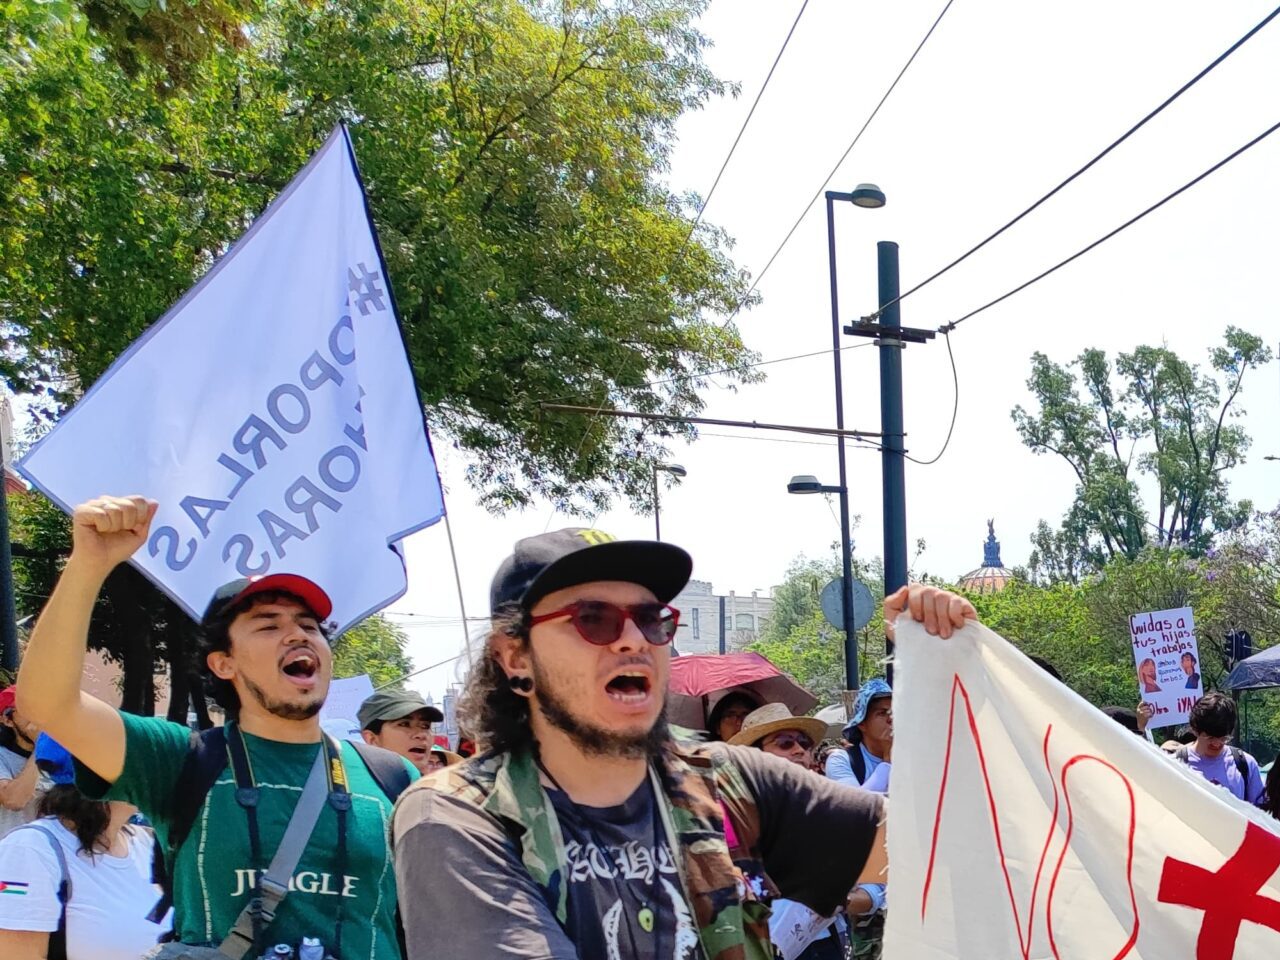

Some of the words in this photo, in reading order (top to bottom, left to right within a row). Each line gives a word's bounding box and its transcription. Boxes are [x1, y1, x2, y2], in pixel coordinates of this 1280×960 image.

[1130, 613, 1172, 635] Cuidas
[1176, 617, 1185, 629] a
[1133, 636, 1156, 649] tus
[1162, 630, 1190, 644] hijas
[1151, 641, 1193, 657] trabajas
